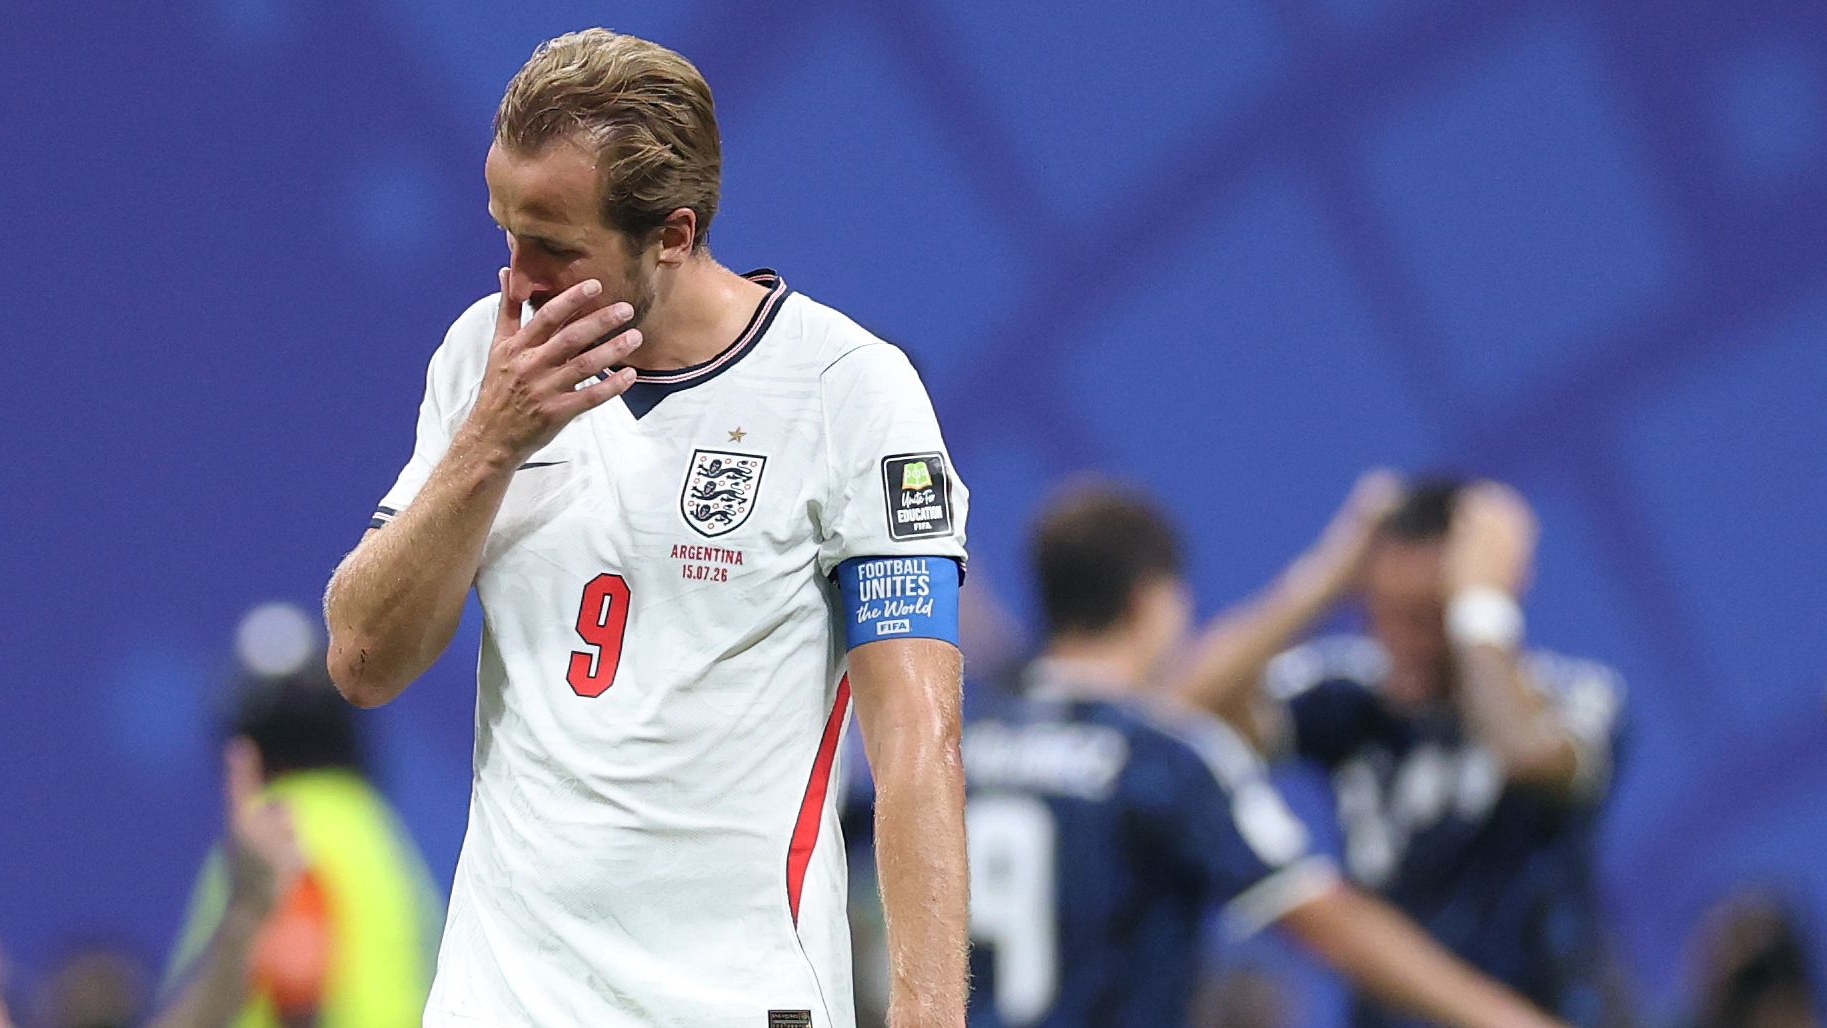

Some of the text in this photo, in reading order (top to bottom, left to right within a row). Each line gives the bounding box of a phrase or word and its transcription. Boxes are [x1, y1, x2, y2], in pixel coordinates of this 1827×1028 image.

[897, 505, 943, 523] EDUCATION
[913, 521, 932, 531] FIFA
[670, 543, 743, 566] ARGENTINA
[682, 563, 728, 582] 15.07.26
[858, 559, 930, 580] FOOTBALL
[859, 575, 930, 602] UNITES
[856, 597, 933, 623] the World
[566, 572, 631, 698] 9
[879, 621, 908, 633] FIFA
